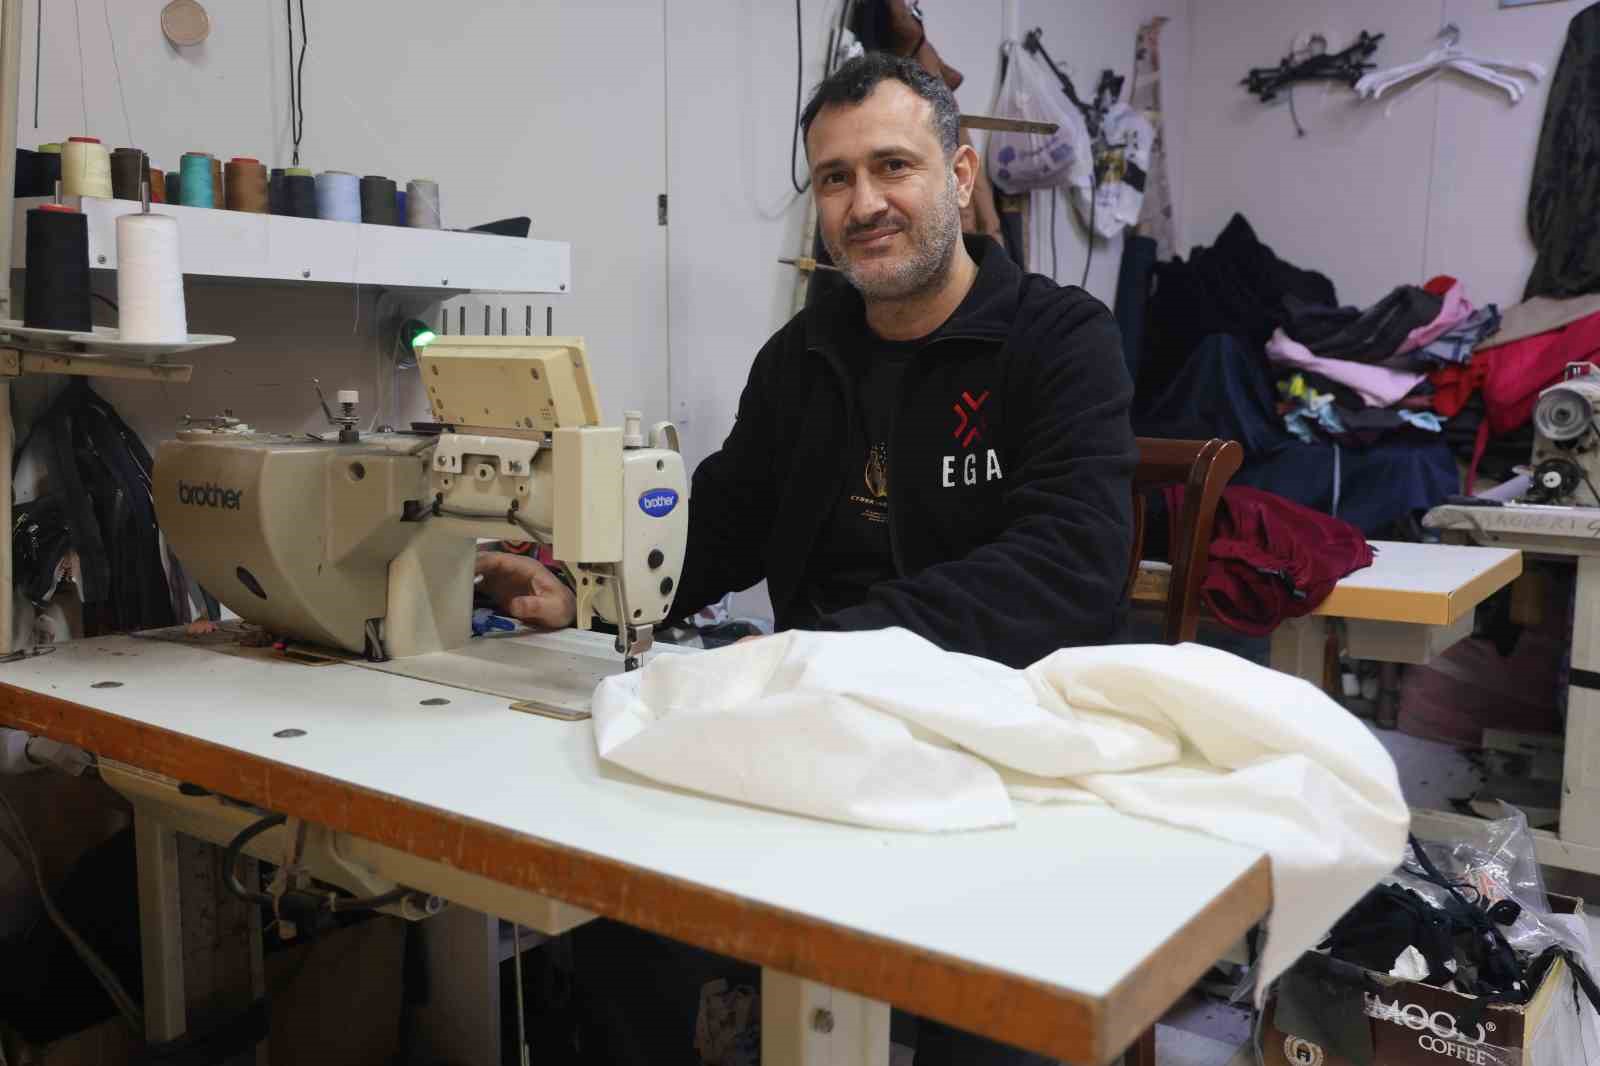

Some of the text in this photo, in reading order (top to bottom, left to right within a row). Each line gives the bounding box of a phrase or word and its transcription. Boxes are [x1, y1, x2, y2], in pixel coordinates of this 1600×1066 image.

[942, 448, 1003, 488] EGA
[178, 480, 243, 511] brother
[644, 495, 675, 509] brother
[1418, 1034, 1488, 1066] COFFEE
